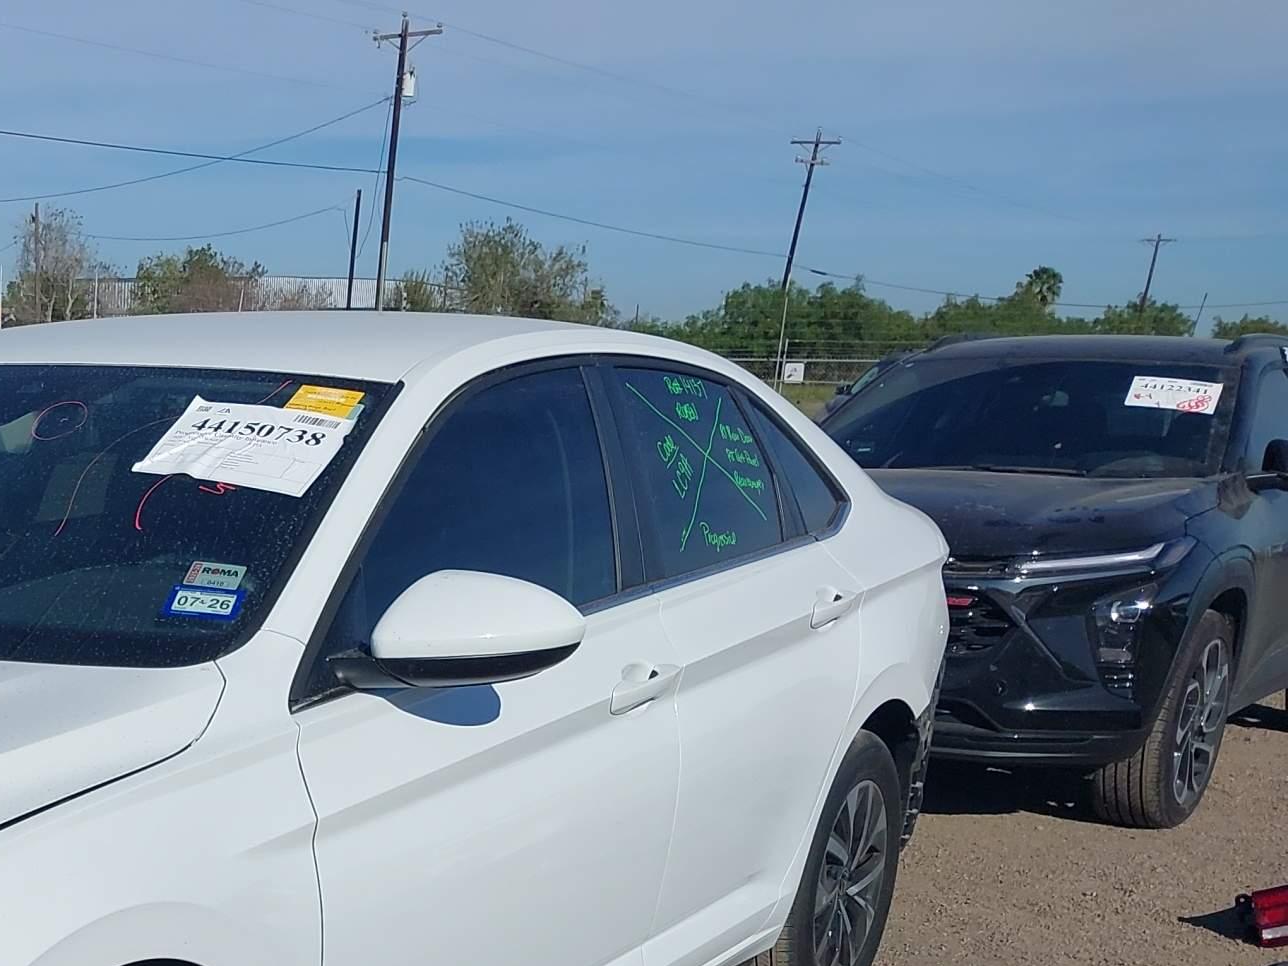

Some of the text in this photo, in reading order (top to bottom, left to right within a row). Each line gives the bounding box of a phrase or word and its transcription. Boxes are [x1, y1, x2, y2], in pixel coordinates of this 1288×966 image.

[191, 418, 326, 447] 44150738
[177, 595, 232, 610] 07 26
